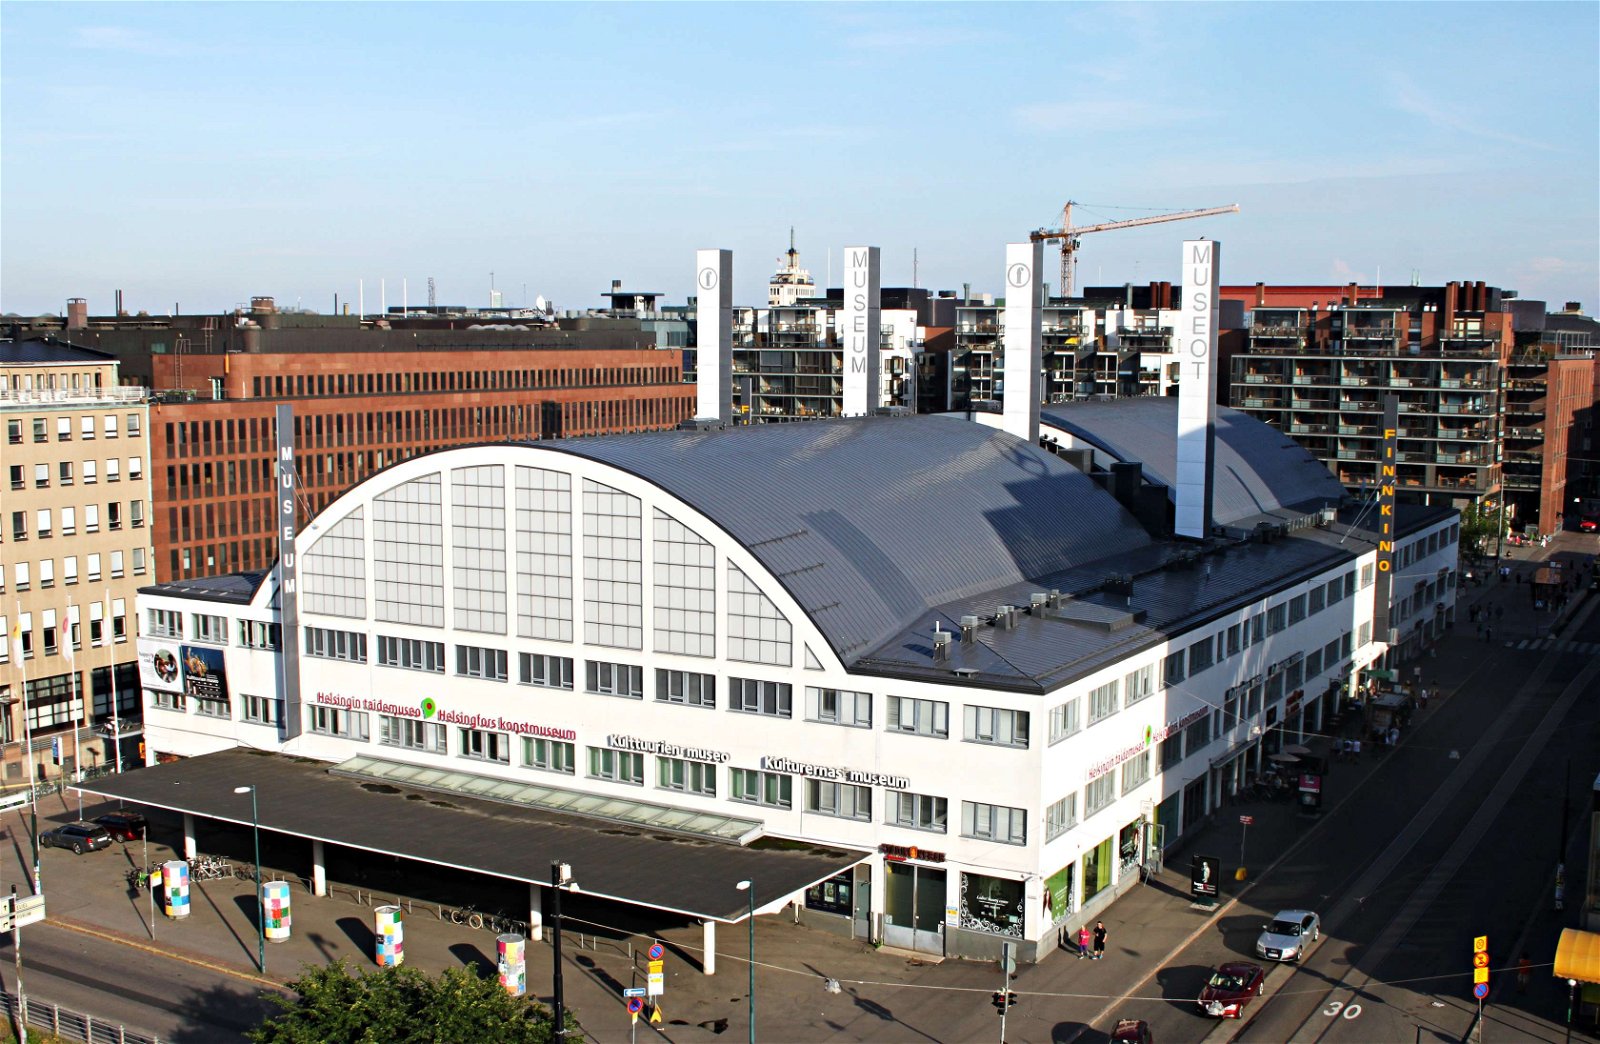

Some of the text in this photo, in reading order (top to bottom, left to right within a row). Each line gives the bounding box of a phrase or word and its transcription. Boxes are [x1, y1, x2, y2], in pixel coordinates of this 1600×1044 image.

[851, 251, 867, 373] MUSEUM
[1190, 245, 1210, 379] MUSEOT
[1378, 428, 1396, 572] FINNKINO
[281, 446, 296, 593] MUSEUM
[316, 691, 421, 718] Helsingin taidemuseo
[437, 709, 577, 741] Helsingfors konstmuseum
[606, 733, 731, 763] Kulttuurien museo
[760, 755, 911, 789] Kulturernas museum
[1323, 1001, 1362, 1020] 30
